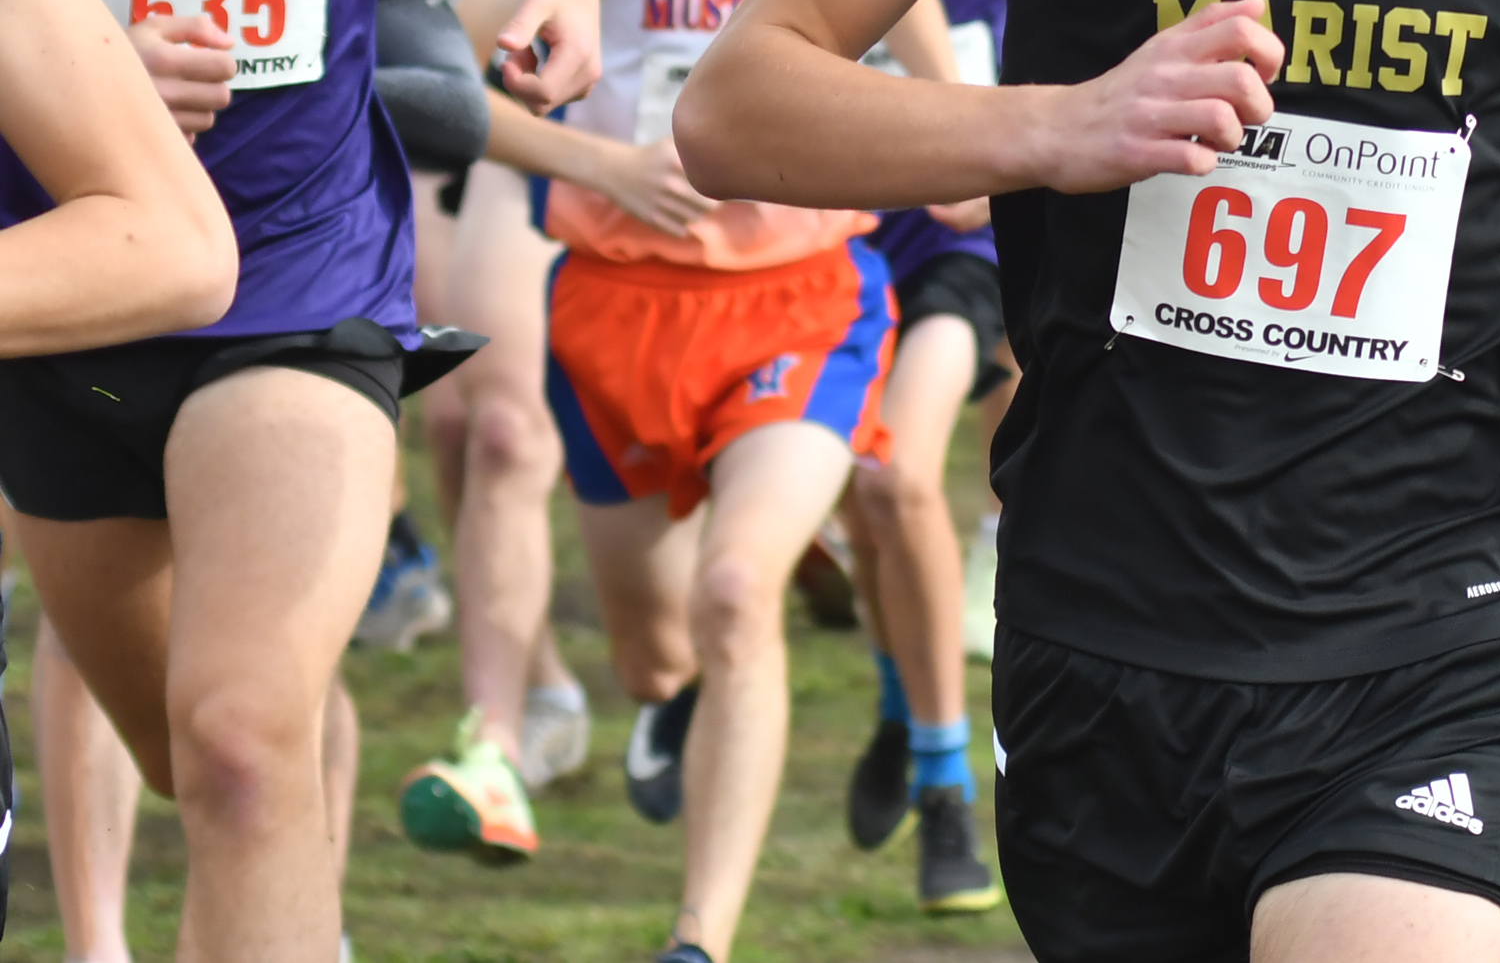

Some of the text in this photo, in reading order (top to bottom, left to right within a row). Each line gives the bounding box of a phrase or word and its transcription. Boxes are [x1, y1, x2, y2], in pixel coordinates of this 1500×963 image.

[1305, 133, 1440, 180] OnPoint
[1302, 169, 1435, 193] COMMUNITY CREDIT UNION
[1182, 186, 1407, 319] 697
[1155, 303, 1410, 362] CROSS COUNTRY
[1234, 344, 1280, 357] Presented by
[1395, 793, 1484, 836] adidas
